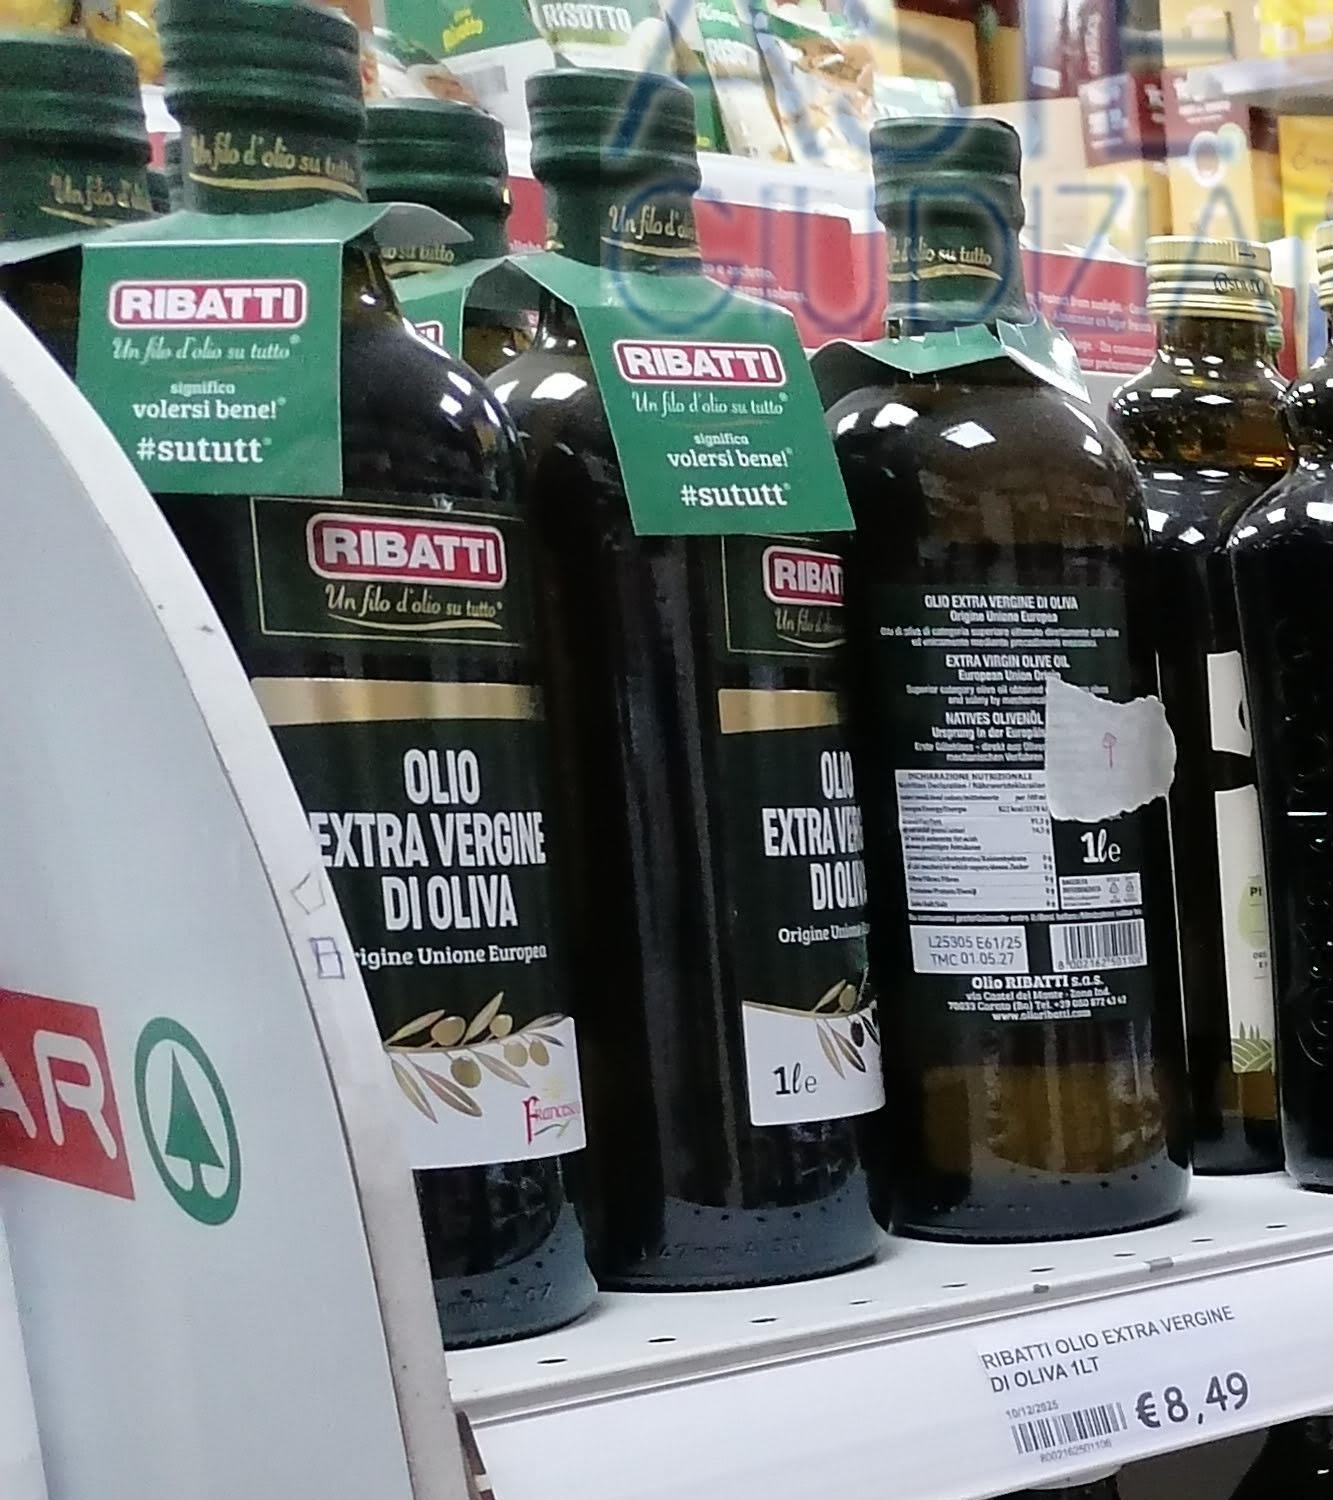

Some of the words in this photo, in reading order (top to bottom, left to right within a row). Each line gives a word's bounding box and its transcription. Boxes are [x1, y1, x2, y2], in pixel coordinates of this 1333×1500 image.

[542, 4, 632, 33] RISOTTO
[119, 287, 297, 321] RIBATTI
[112, 337, 140, 361] Un
[140, 335, 172, 366] filo
[175, 335, 222, 361] d'olio
[226, 346, 245, 360] su
[250, 341, 290, 361] tutto
[622, 348, 779, 380] RIBATTI
[169, 380, 236, 398] significa
[132, 400, 210, 420] volersi
[215, 400, 278, 420] bene!
[632, 391, 658, 413] Un
[660, 390, 685, 418] filo
[689, 391, 728, 414] d'olio
[731, 402, 748, 414] su
[750, 397, 784, 415] tutto
[136, 437, 264, 464] #sututt
[693, 433, 750, 448] significa
[667, 450, 735, 468] volersi
[739, 449, 789, 468] bene!
[680, 484, 788, 508] #sututt
[322, 527, 498, 575] RIBATTI
[324, 584, 356, 610] Un
[357, 585, 391, 617] filo
[396, 587, 441, 617] d'olio
[445, 602, 462, 618] su
[465, 599, 498, 619] tutto
[951, 595, 987, 609] EXTRA
[989, 595, 1036, 609] VERGINE
[1035, 596, 1048, 609] DI
[1049, 596, 1079, 610] OLIVA
[945, 654, 982, 669] EXTRA
[982, 654, 1020, 669] VIRGIN
[1021, 654, 1052, 669] OLIVE
[1052, 655, 1071, 669] OIL
[945, 711, 991, 726] NATIVES
[991, 709, 1045, 726] OLIVENÖL
[404, 749, 482, 806] OLIO
[820, 750, 856, 802] OLIO
[310, 811, 428, 868] EXTRA
[437, 811, 548, 868] VERGINE
[762, 806, 834, 859] EXTRA
[810, 865, 833, 910] DI
[381, 876, 424, 932] DI
[428, 874, 519, 931] OLIVA
[777, 925, 829, 947] Origine
[928, 935, 974, 950] L25305
[976, 934, 1023, 951] E61/25
[352, 944, 414, 968] rigine
[418, 943, 487, 967] Unione
[488, 943, 548, 967] Europea
[931, 952, 958, 968] TMC
[959, 951, 1015, 968] 01.05.27
[971, 976, 1003, 990] Olio
[1004, 974, 1069, 990] RIBATTI
[1070, 974, 1105, 988] s.a.s.
[980, 1340, 1053, 1370] RIBATTI
[1055, 1332, 1100, 1356] OLIO
[1101, 1320, 1161, 1347] EXTRA
[1160, 1304, 1236, 1334] VERGINE
[989, 1375, 1010, 1394] DI
[1014, 1363, 1070, 1390] OLIVA
[1070, 1355, 1101, 1379] 1LT
[1134, 1371, 1250, 1430] €8,49
